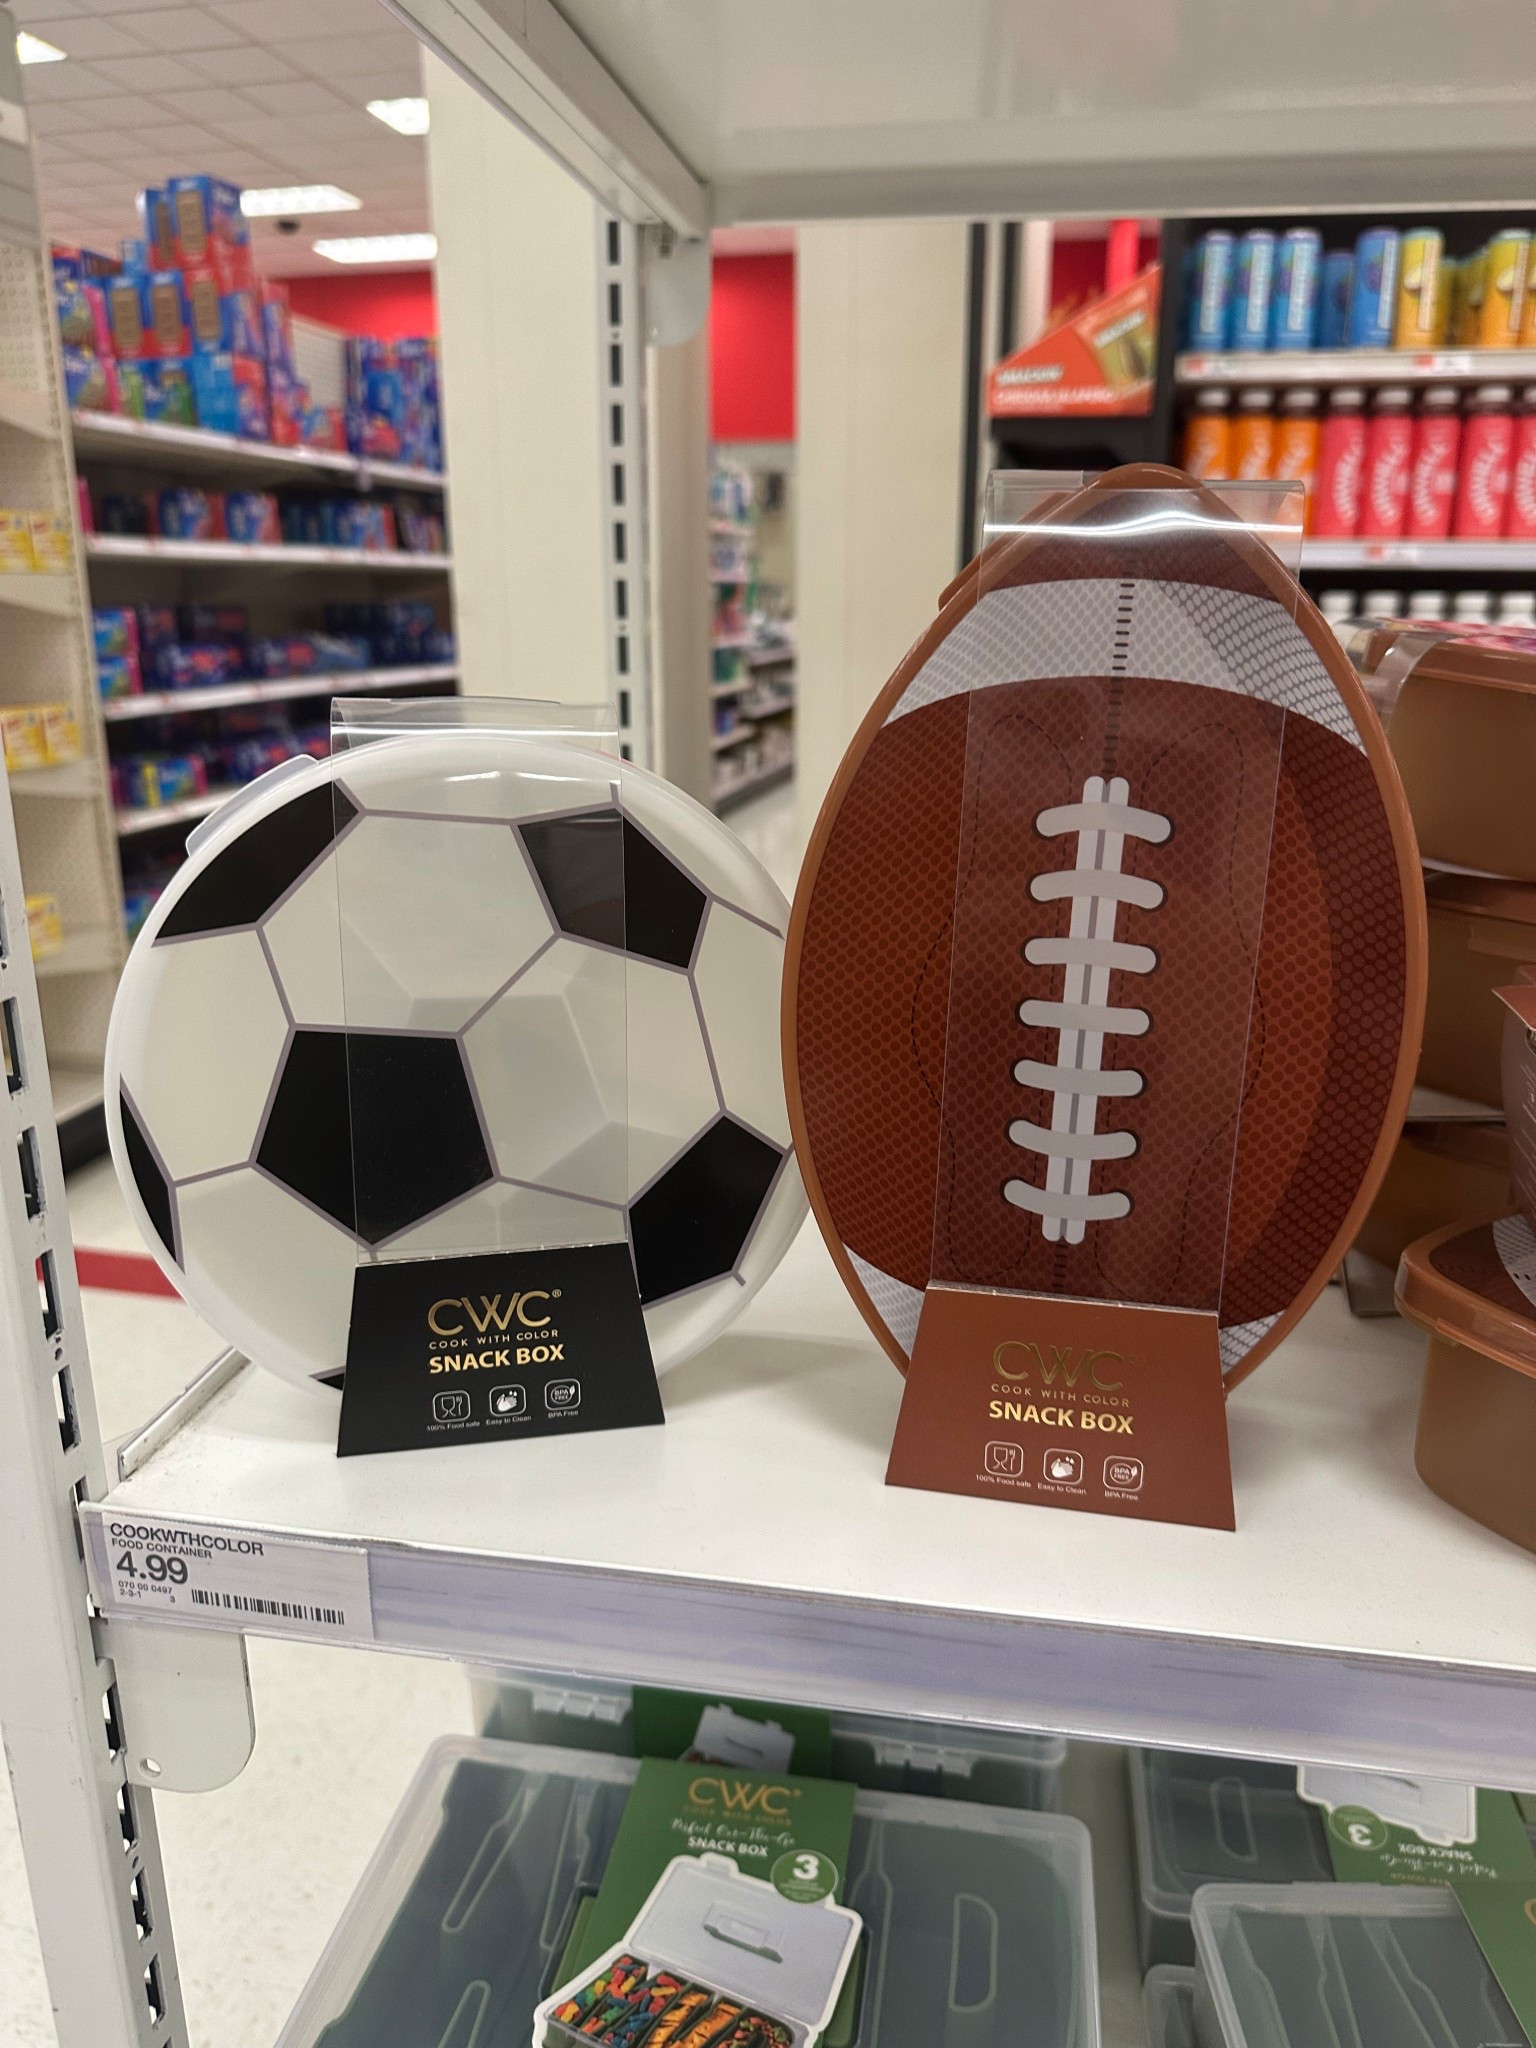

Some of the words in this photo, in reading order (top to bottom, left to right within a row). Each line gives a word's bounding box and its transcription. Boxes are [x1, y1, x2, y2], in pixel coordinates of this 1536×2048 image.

[429, 1337, 469, 1350] COOK
[476, 1333, 510, 1346] WITH
[516, 1329, 560, 1340] COLOR
[429, 1348, 511, 1374] SNACK
[516, 1344, 564, 1366] BOX
[991, 1383, 1032, 1398] COOK
[1041, 1387, 1078, 1401] WITH
[1083, 1394, 1130, 1408] COLOR
[426, 1424, 446, 1432] 100%
[447, 1422, 464, 1430] Food
[466, 1420, 480, 1428] safe
[486, 1418, 502, 1426] Easy
[988, 1400, 1074, 1428] SNACK
[1080, 1410, 1134, 1435] BOX
[976, 1474, 996, 1484] 100%
[996, 1477, 1014, 1486] Food
[1016, 1480, 1032, 1488] safe
[1038, 1482, 1055, 1492] Easy
[1056, 1484, 1064, 1492] to
[1066, 1487, 1087, 1495] Clean
[1104, 1490, 1121, 1498] BPA
[1122, 1493, 1138, 1501] Free
[110, 1523, 264, 1556] COOKWTHCOLOR
[112, 1538, 143, 1550] FOOD
[146, 1542, 212, 1559] CONTAINER
[116, 1551, 188, 1584] 4.99
[118, 1580, 135, 1590] 070
[137, 1582, 149, 1592] 00
[1348, 1824, 1372, 1846] 3
[688, 1836, 736, 1852] SNACK
[738, 1843, 768, 1857] BOX
[1397, 1843, 1426, 1857] BOX
[1428, 1846, 1474, 1862] SNACK
[792, 1854, 820, 1880] 3
